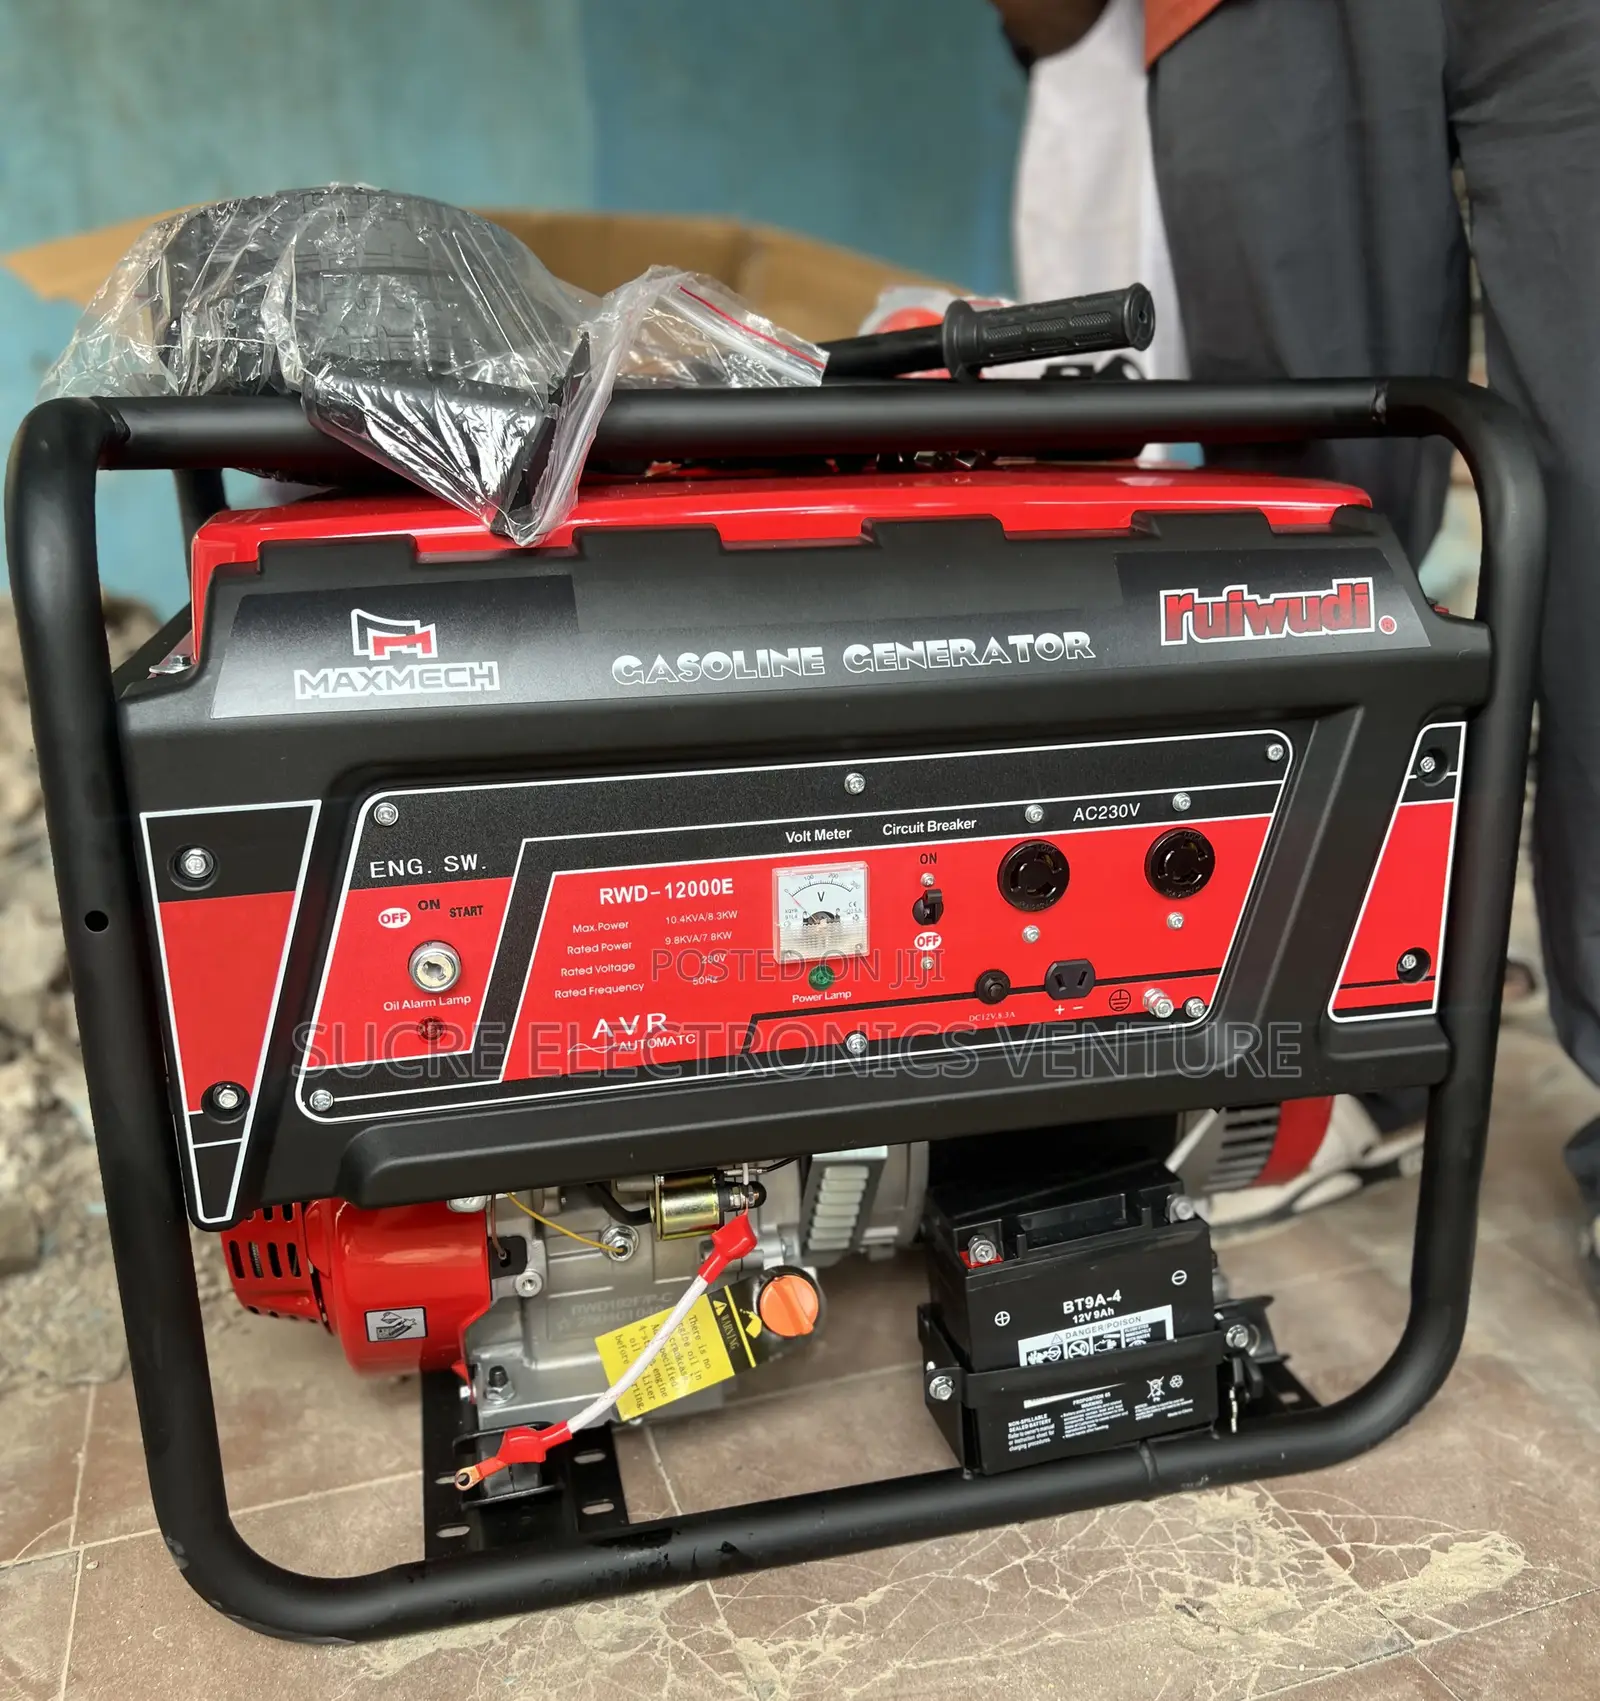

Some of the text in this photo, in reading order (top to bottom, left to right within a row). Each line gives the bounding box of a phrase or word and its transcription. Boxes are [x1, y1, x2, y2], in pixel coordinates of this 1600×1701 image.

[1160, 576, 1375, 646] ruiwudi
[611, 631, 1096, 686] GASOLINE GENERATOR
[294, 661, 500, 699] MAXMECH
[1073, 803, 1140, 822] AC230V
[785, 828, 852, 843] Volt Meter
[882, 818, 977, 836] Circuit Breaker
[370, 854, 487, 879] ENG. SW.
[920, 852, 937, 865] ON
[599, 878, 734, 905] RWD-12000E
[817, 891, 825, 902] V
[417, 899, 440, 911] ON
[449, 905, 484, 918] START
[380, 912, 408, 924] OFF
[572, 910, 739, 934] Max.Power 10.4KVA/8.3KW
[567, 931, 732, 955] Rated Power 9.8KVA/7.8KW
[917, 935, 939, 948] OFF
[560, 966, 593, 978] Rated
[595, 962, 635, 975] Voltage
[554, 975, 718, 999] Rated Frequency 50Hz
[792, 990, 852, 1004] Power Lamp
[383, 995, 472, 1012] Oil Alarm Lamp
[1063, 1289, 1122, 1314] BT9A-4
[1072, 1307, 1115, 1324] 12V 9Ah
[689, 1315, 711, 1370] There is no
[721, 1314, 740, 1350] WARNING
[615, 1334, 630, 1365] before
[687, 1351, 698, 1366] oil
[629, 1337, 656, 1401] oil Liter
[654, 1368, 668, 1398] engine
